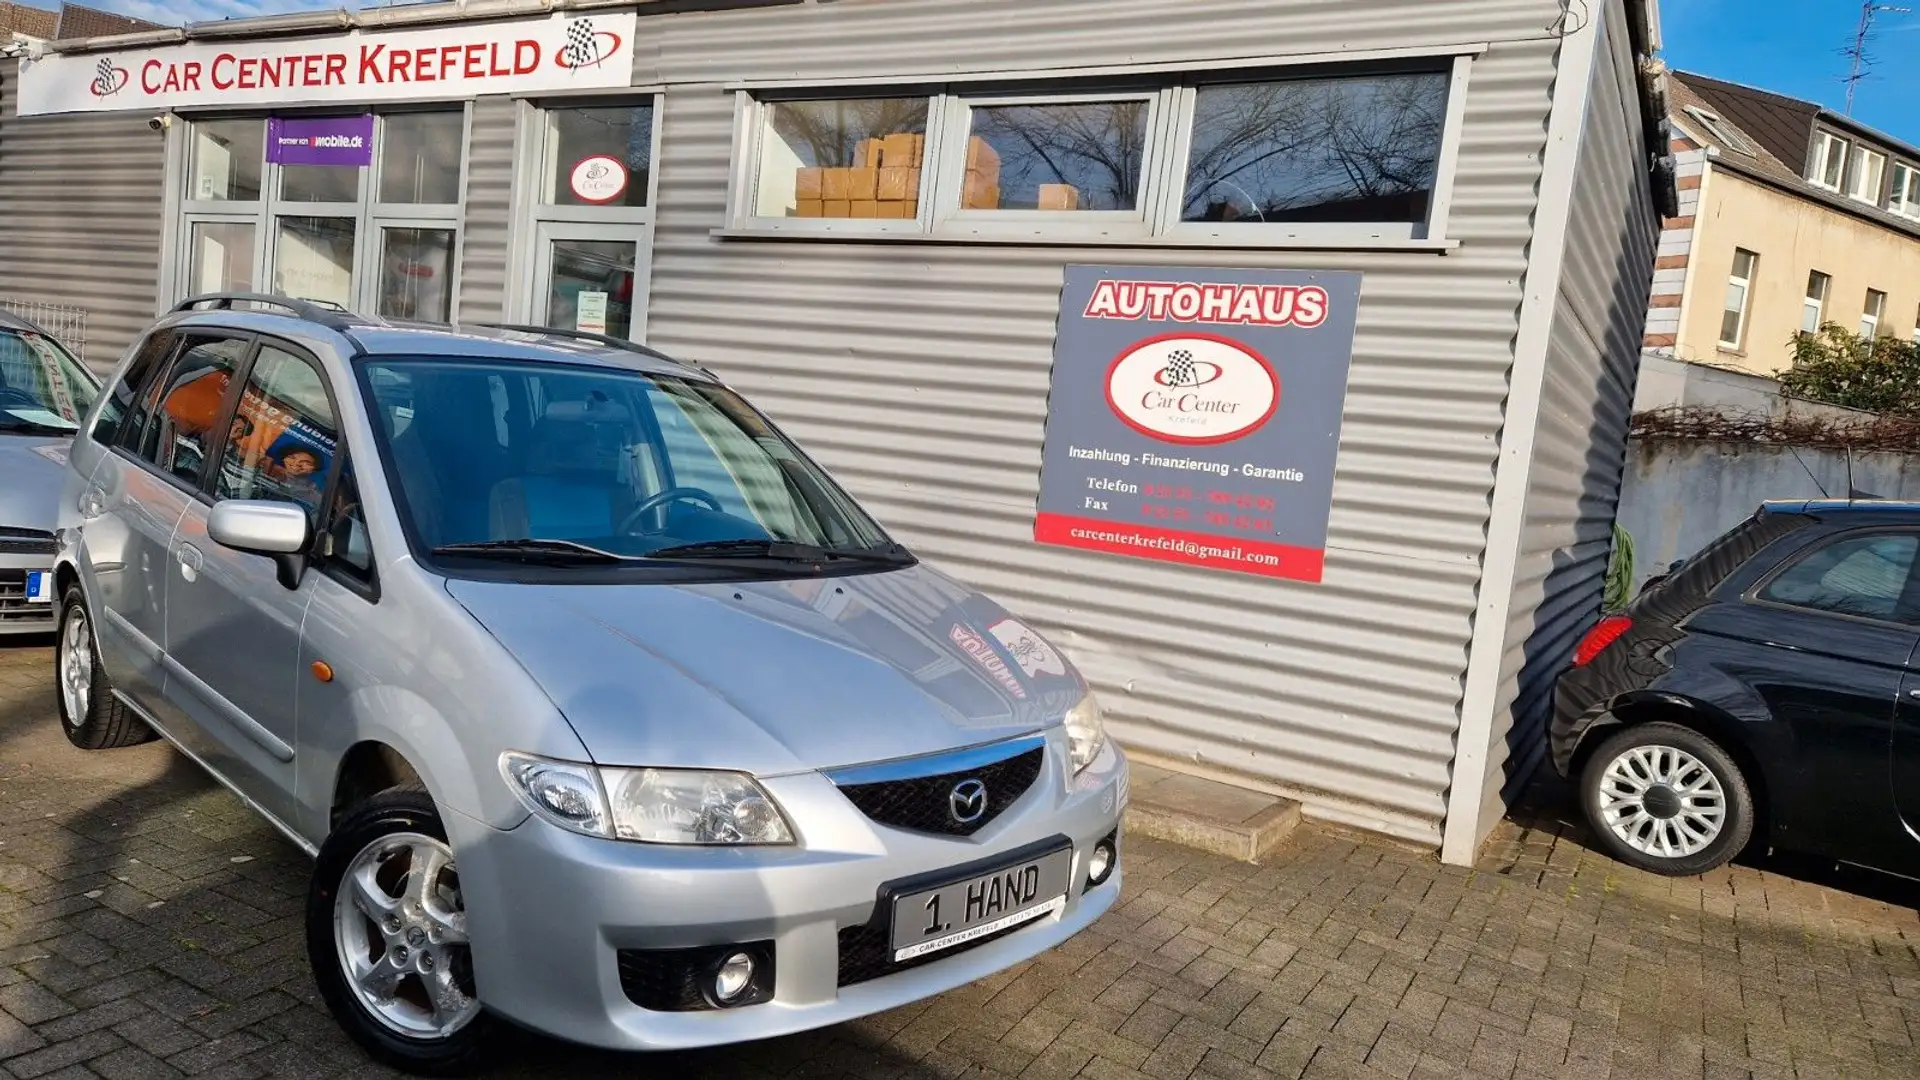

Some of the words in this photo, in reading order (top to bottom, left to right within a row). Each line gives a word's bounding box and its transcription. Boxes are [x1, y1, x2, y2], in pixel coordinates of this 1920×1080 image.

[141, 59, 202, 95] CAR
[211, 53, 347, 90] CENTER
[358, 39, 541, 84] KREFELD
[1084, 280, 1329, 328] AUTOHAUS
[1142, 391, 1176, 410] Car
[1178, 393, 1241, 414] Center
[1069, 446, 1131, 466] Inzahlung
[1142, 453, 1230, 477] Finanzierung
[1242, 463, 1304, 483] Garantie
[1084, 496, 1109, 511] Fax
[1087, 477, 1138, 495] Telefon
[1070, 525, 1280, 566] carcenterkrefeld@gmail.com
[923, 893, 951, 935] 1.
[964, 865, 1040, 923] HAND
